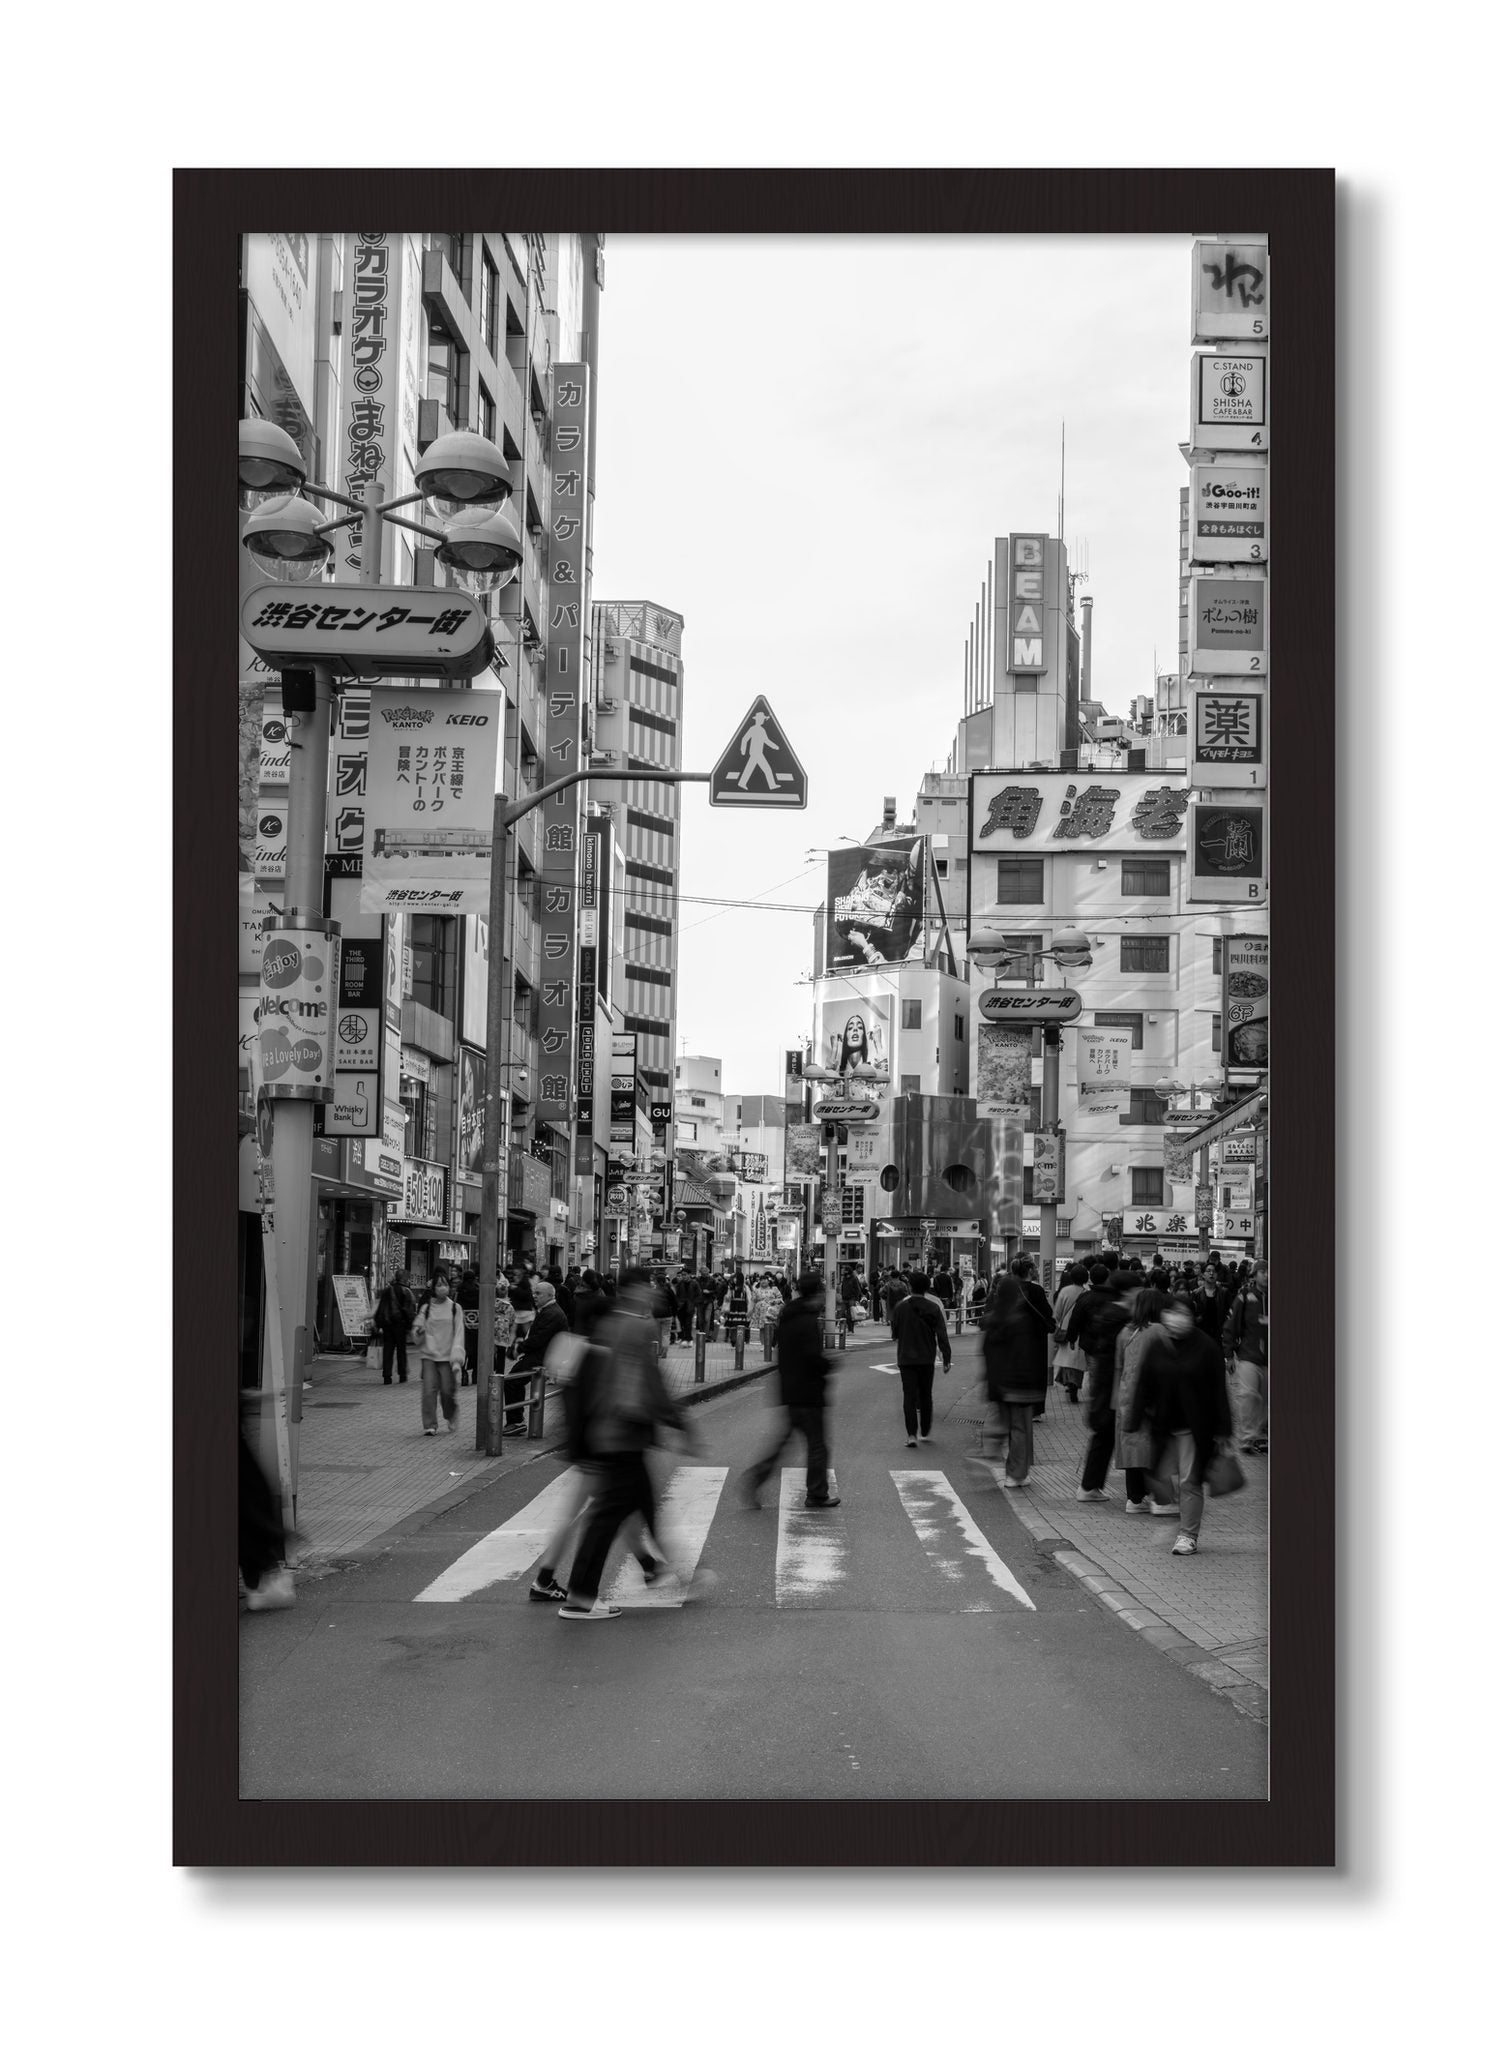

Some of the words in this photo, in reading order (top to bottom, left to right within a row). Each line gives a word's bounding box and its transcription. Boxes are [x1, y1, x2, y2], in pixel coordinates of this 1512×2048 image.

[352, 245, 389, 367] カラオケ
[1252, 321, 1263, 334] 5
[1213, 362, 1253, 371] C.STAND
[1213, 398, 1253, 408] SHISHA
[1251, 432, 1262, 445] 4
[1201, 524, 1261, 535] 全身もみほぐし
[1250, 544, 1260, 558] 3
[1014, 539, 1043, 666] BEAM
[252, 602, 472, 635] 渋谷センター街
[1250, 657, 1260, 670] 2
[392, 721, 424, 729] KANTO
[446, 714, 488, 726] KEIO
[1205, 700, 1250, 744] 薬
[397, 746, 411, 783] 冒険へ
[450, 747, 465, 799] 京王線で
[413, 746, 429, 812] カントーの
[1250, 771, 1257, 784] 1
[979, 785, 1191, 839] 角海老
[1200, 819, 1253, 863] 一蘭
[586, 838, 594, 869] kimono
[260, 865, 282, 873] 渋谷店
[385, 890, 464, 901] 渋谷センター街
[585, 873, 593, 904] hearts
[1248, 883, 1258, 897] B
[263, 950, 299, 981] Enjoy
[540, 886, 571, 1101] カラオケ館
[985, 997, 1076, 1008] 渋谷センター街
[260, 995, 327, 1018] Welcome
[1228, 1004, 1254, 1022] 6F
[275, 1045, 301, 1064] Lovely
[334, 1105, 364, 1113] Whisky
[334, 1112, 352, 1120] Bank
[653, 1108, 670, 1118] GU
[757, 1212, 765, 1249] BEER
[1136, 1214, 1187, 1232] 兆楽
